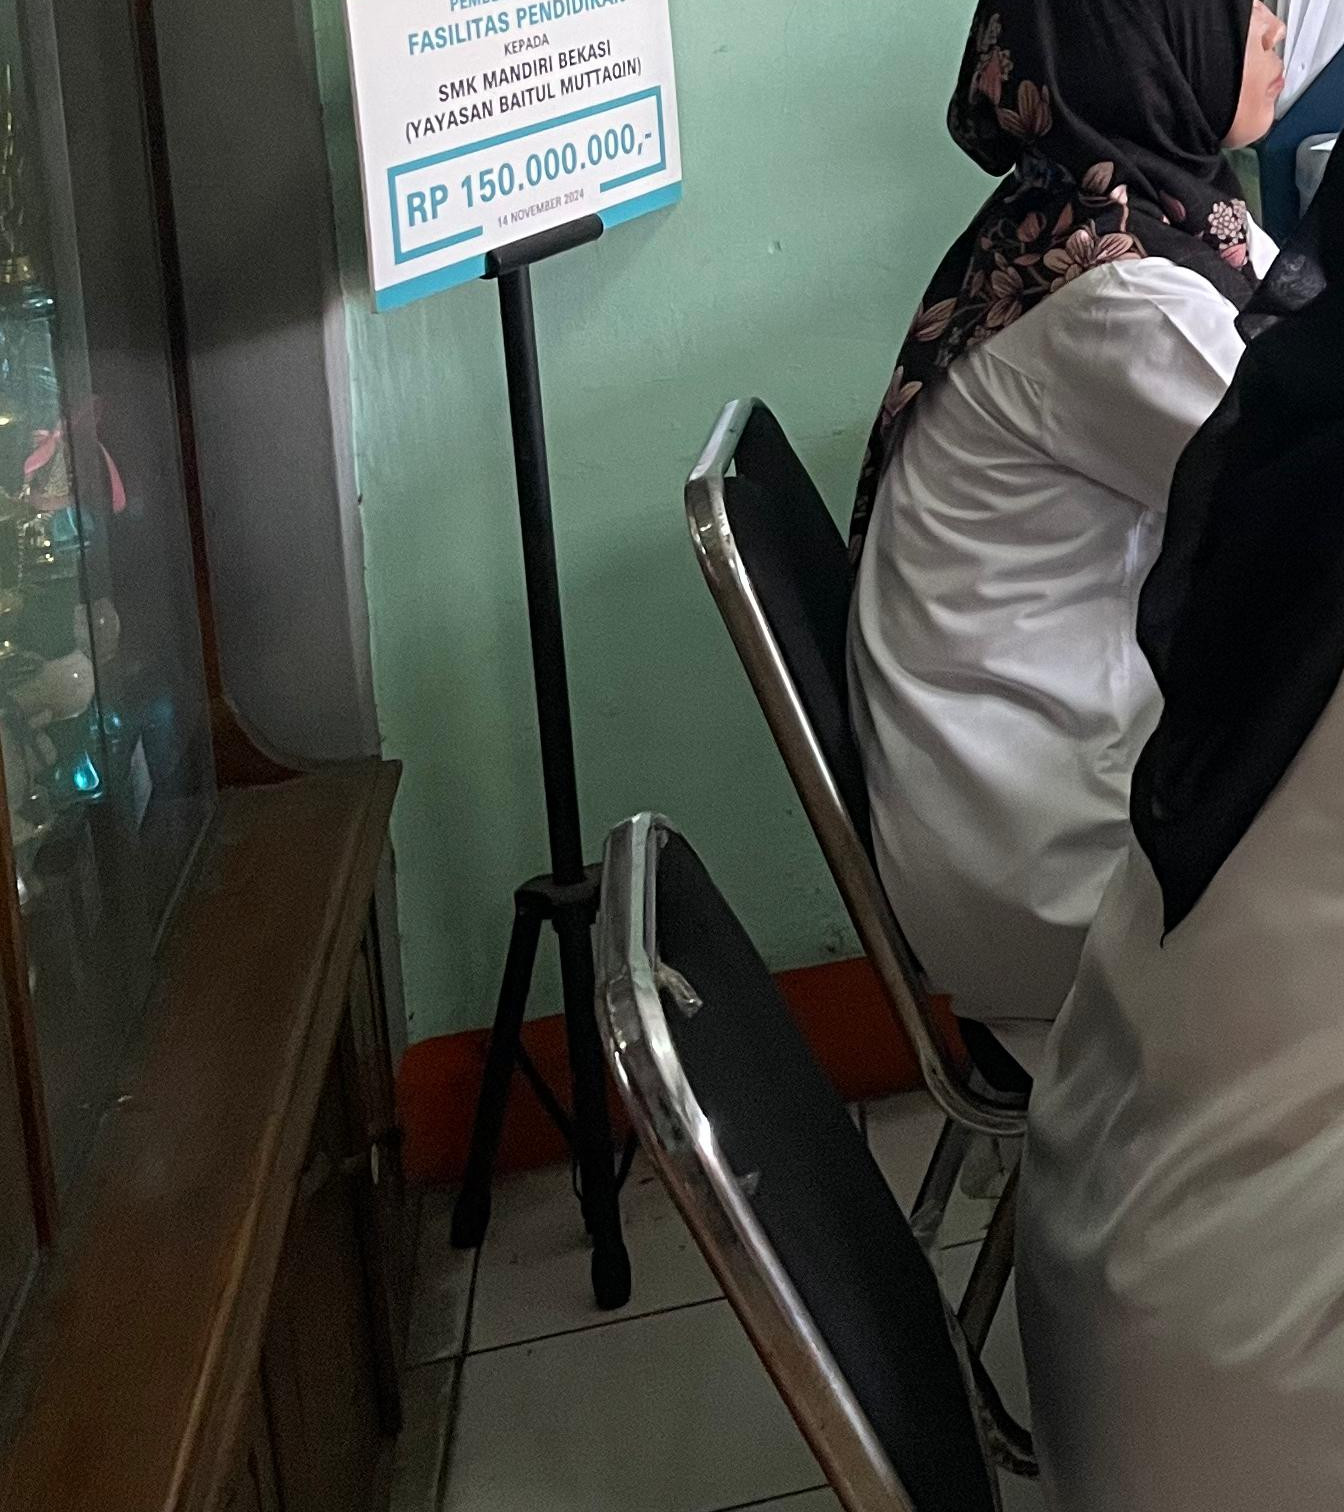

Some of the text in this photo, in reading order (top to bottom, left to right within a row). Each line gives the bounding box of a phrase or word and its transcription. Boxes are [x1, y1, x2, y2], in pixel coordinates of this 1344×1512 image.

[408, 12, 510, 56] FASILITAS
[503, 33, 550, 56] KEPADA
[438, 39, 612, 103] SMK MANDIRI BEKASI
[405, 57, 642, 144] (YAYASAN BAITUL MUTTAQIN)
[407, 123, 653, 227] RP 150.000.000,-
[497, 188, 585, 229] 14 NOVEMBER 2024
